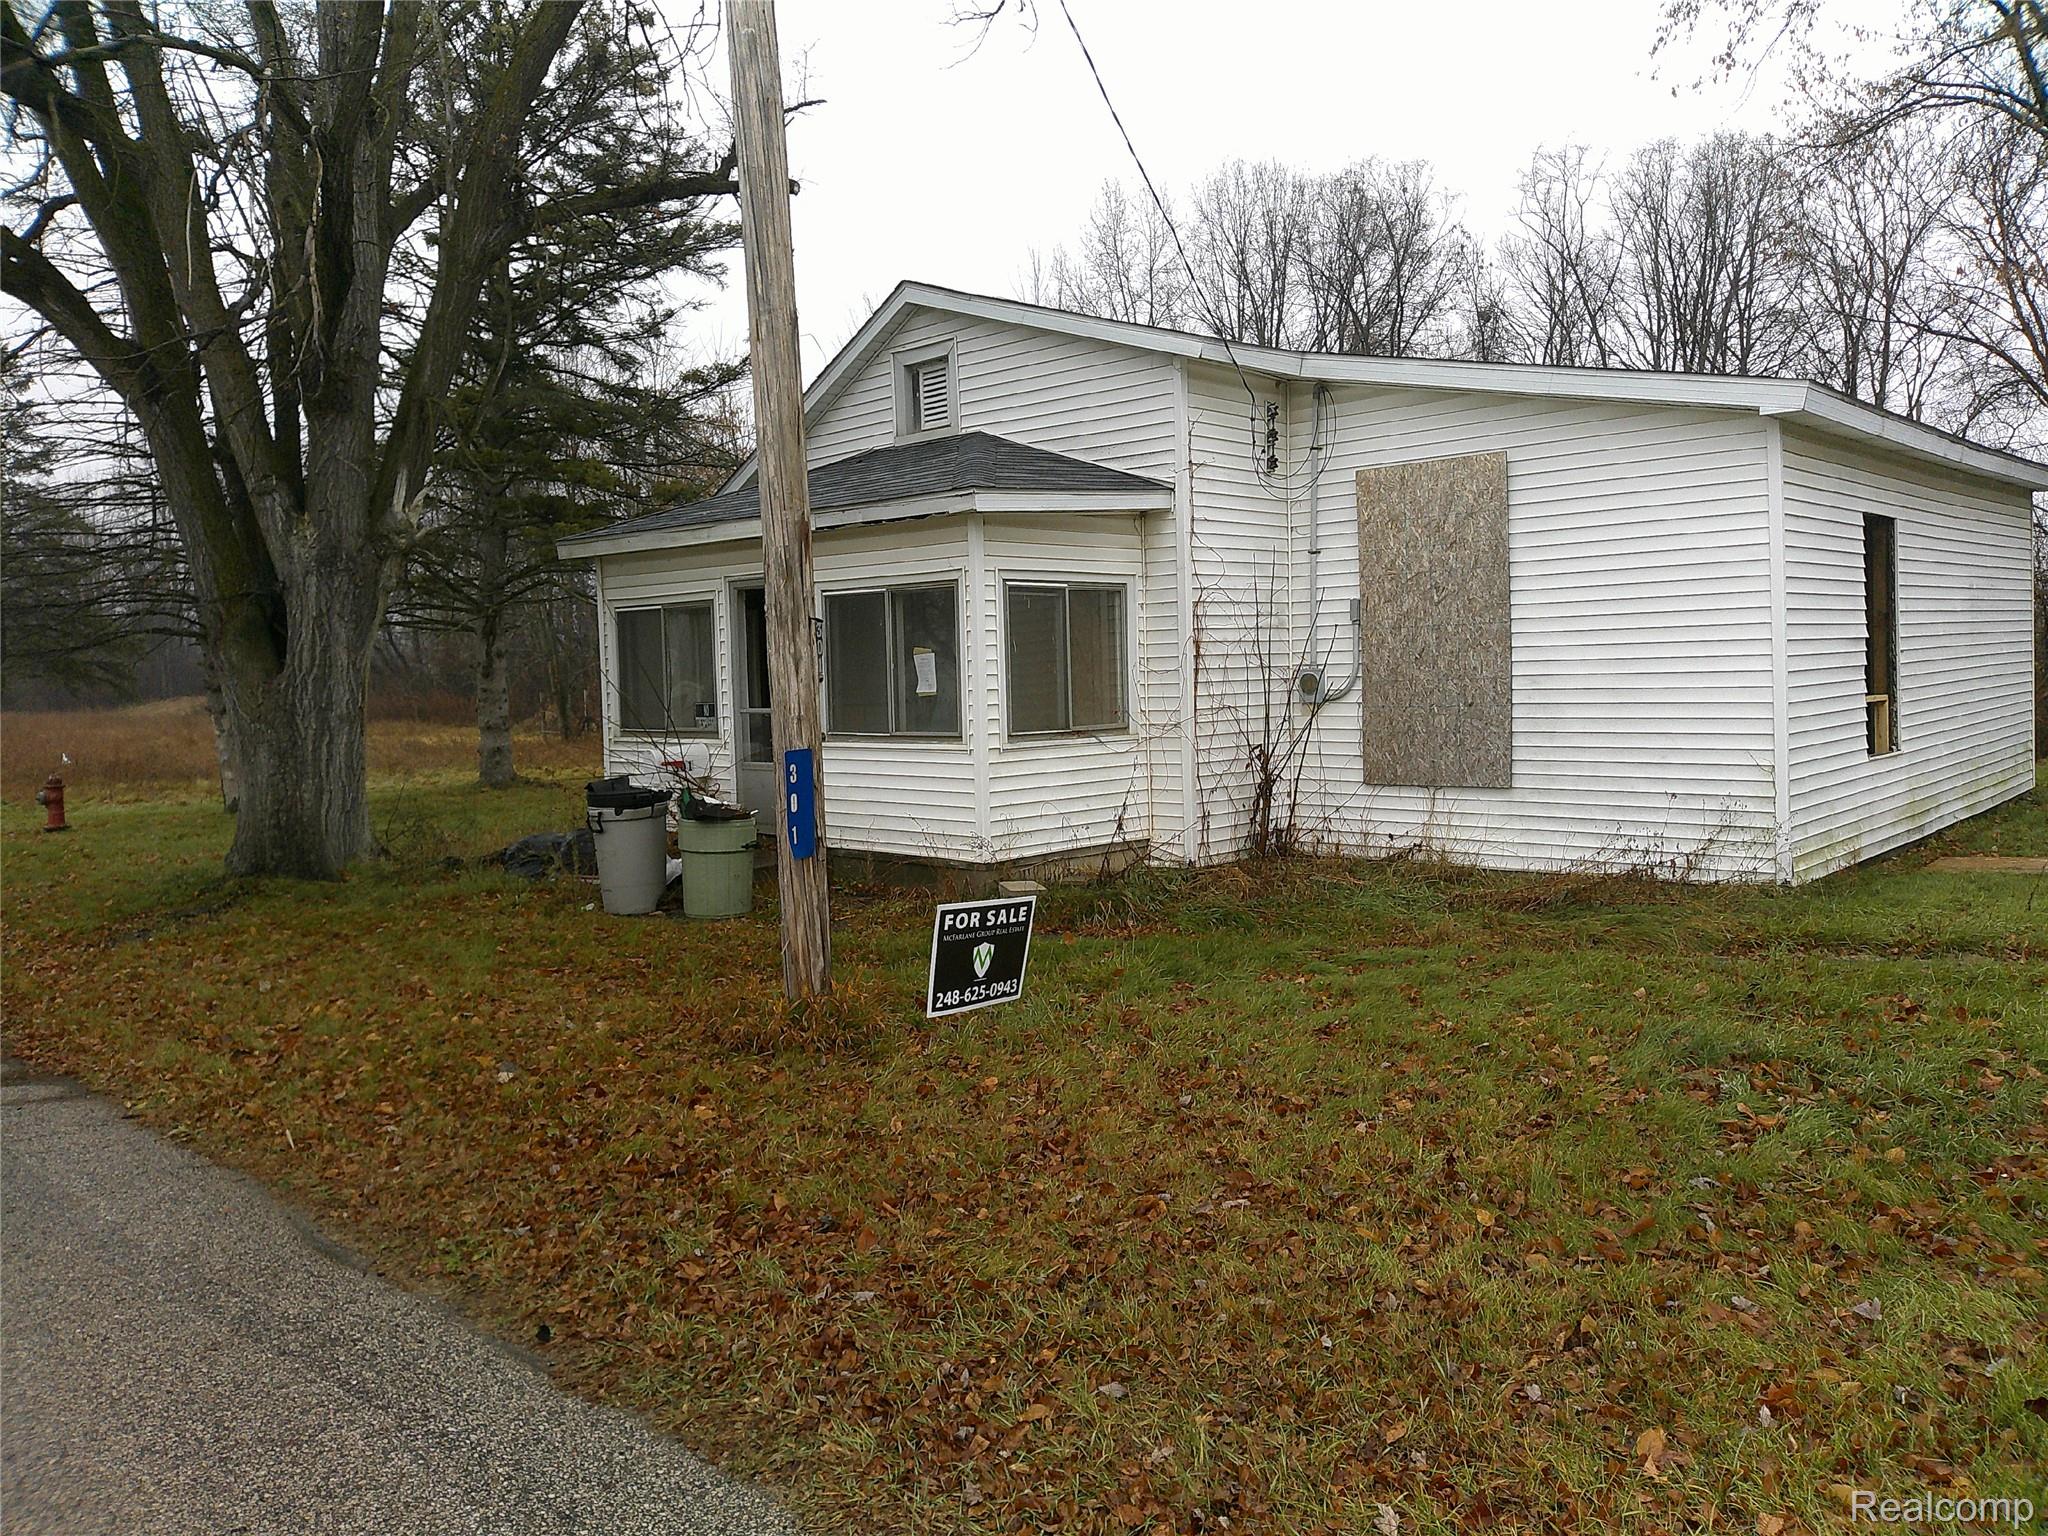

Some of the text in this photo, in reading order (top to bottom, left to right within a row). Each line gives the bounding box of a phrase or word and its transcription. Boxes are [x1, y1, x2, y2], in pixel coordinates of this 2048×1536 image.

[789, 763, 799, 845] 301
[944, 906, 1028, 930] FOR SALE
[935, 978, 1018, 1008] 248-625-0943
